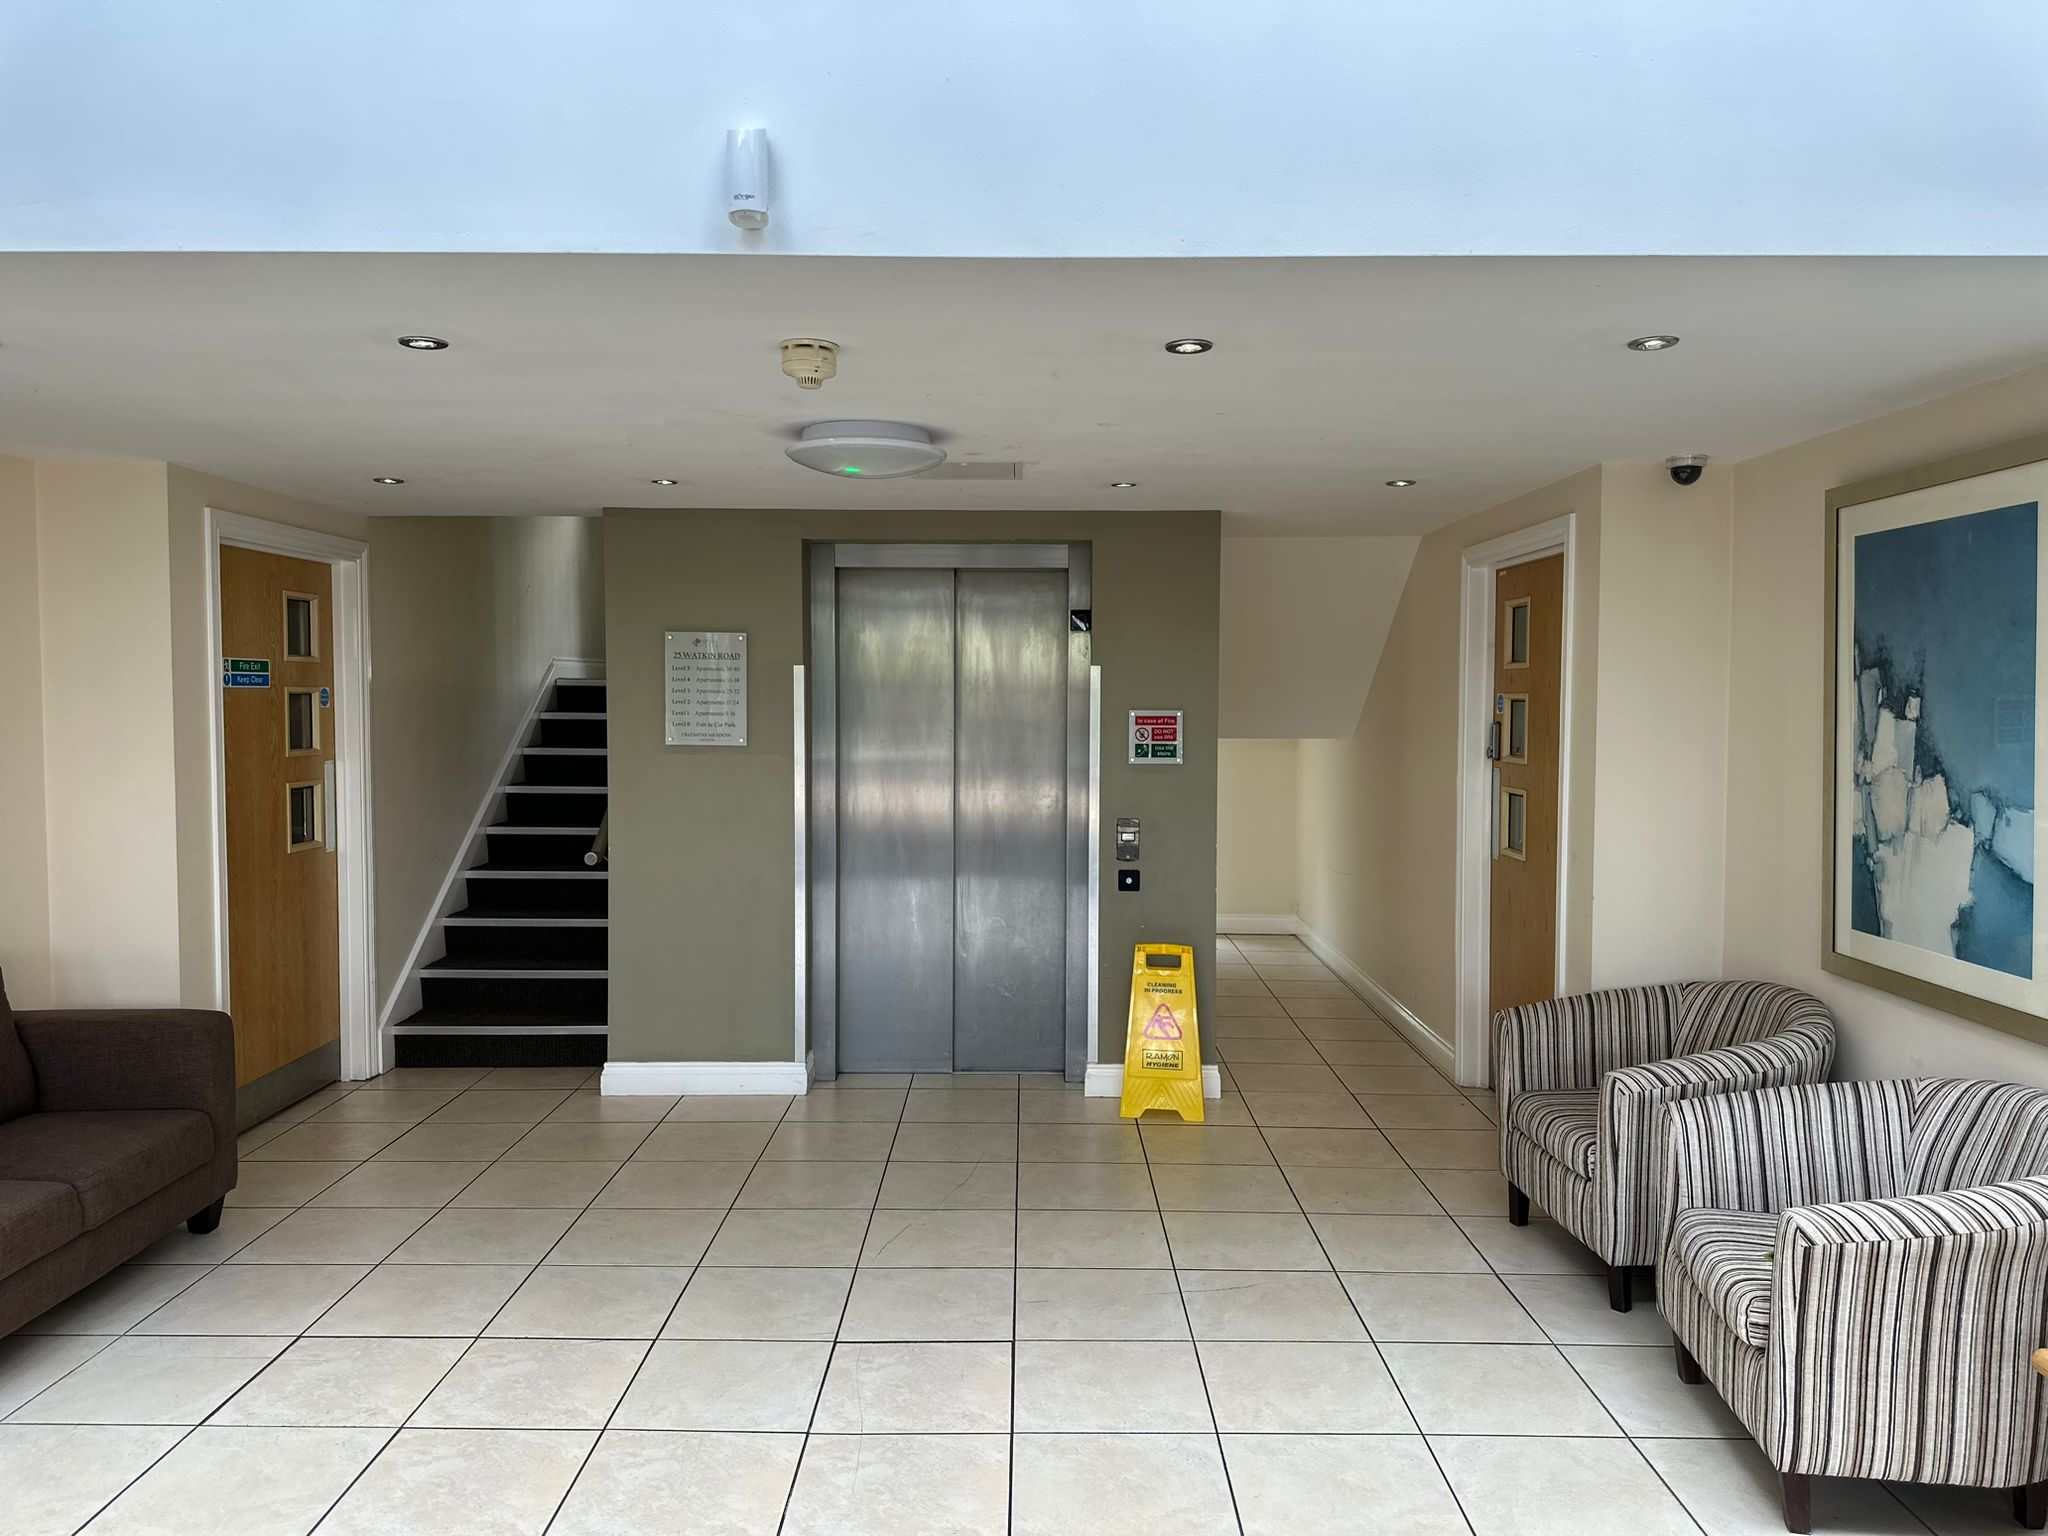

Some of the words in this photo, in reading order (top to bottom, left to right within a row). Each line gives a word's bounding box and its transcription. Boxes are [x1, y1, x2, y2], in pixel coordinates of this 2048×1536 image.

[682, 651, 716, 660] WATKIN
[718, 652, 742, 661] ROAD
[239, 661, 250, 671] Fire
[251, 662, 261, 671] Exit
[237, 675, 250, 685] Keep
[1145, 1060, 1180, 1068] HYGIENE
